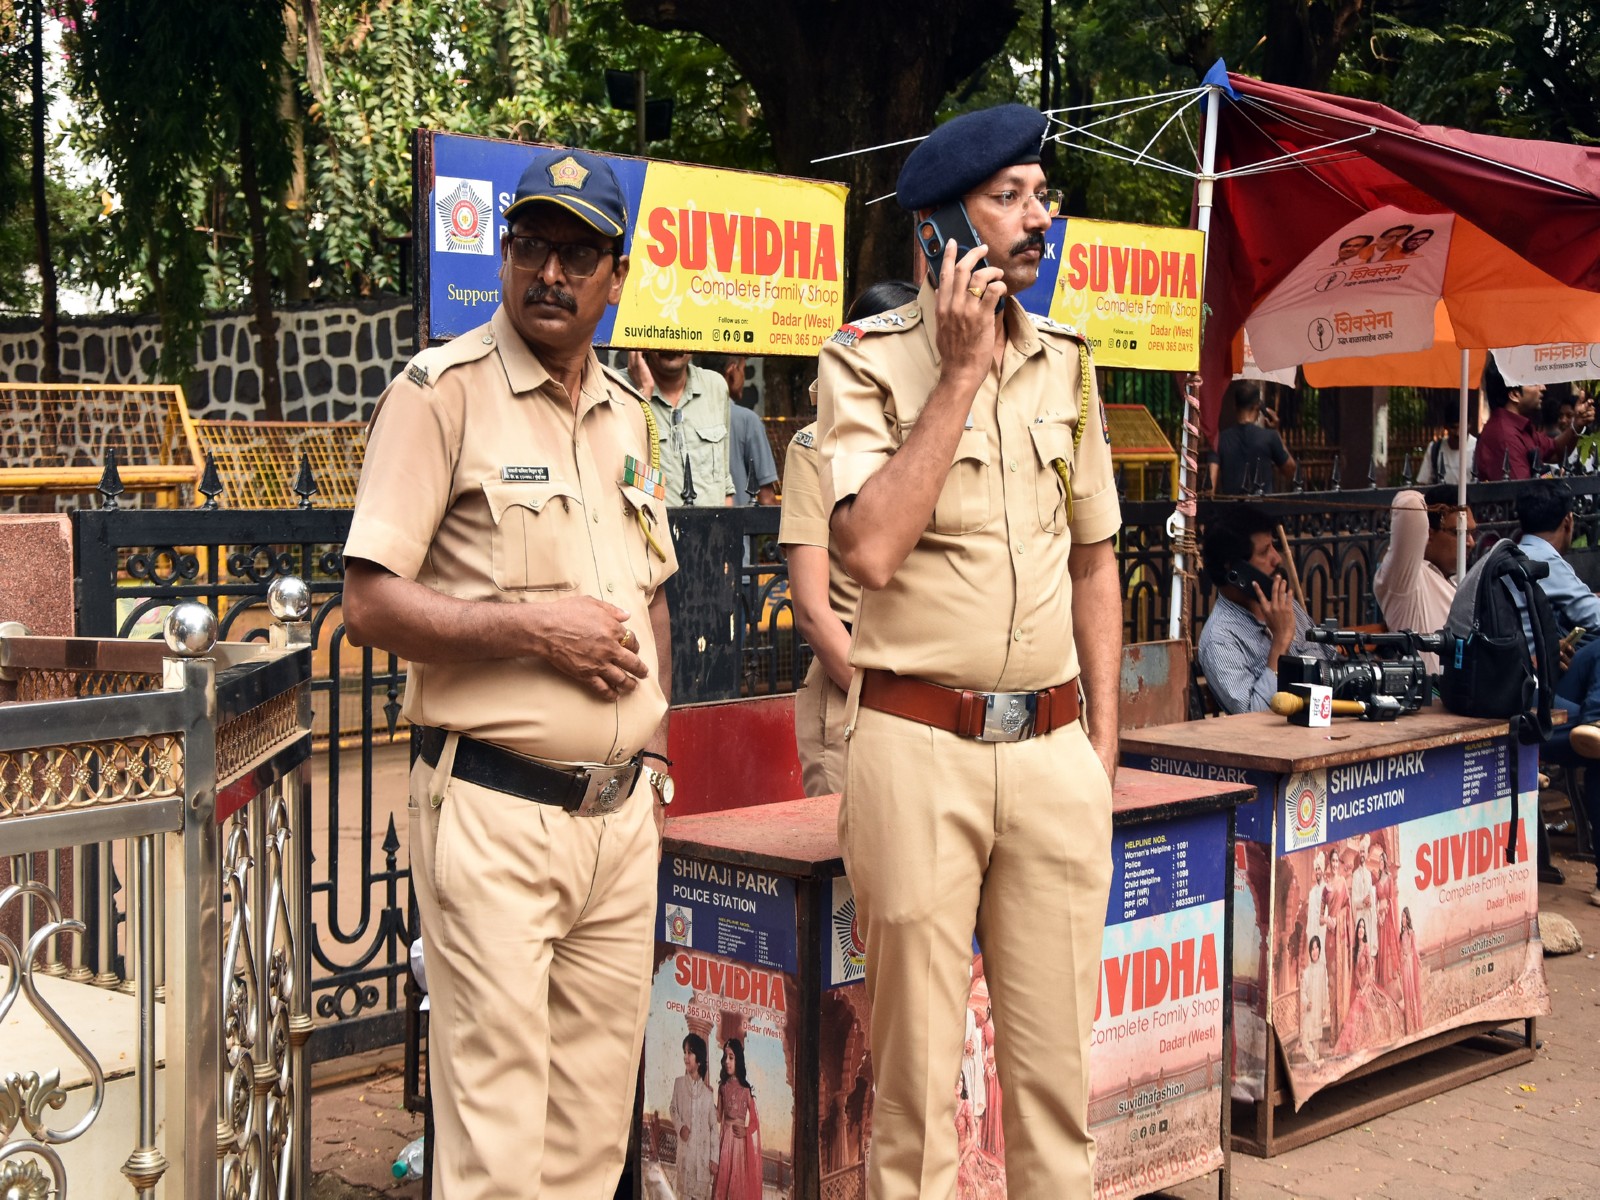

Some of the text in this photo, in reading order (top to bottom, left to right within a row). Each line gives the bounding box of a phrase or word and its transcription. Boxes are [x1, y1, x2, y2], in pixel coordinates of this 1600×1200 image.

[646, 206, 838, 282] SUVIDHA
[1068, 243, 1197, 299] SUVIDHA
[1349, 263, 1410, 280] शिवसेना
[448, 283, 499, 306] Support
[691, 275, 839, 307] Complete Family Shop
[1096, 296, 1198, 319] Complete Family Shop
[718, 316, 734, 324] Follow
[772, 311, 834, 332] Dadar (West)
[1150, 324, 1194, 338] Dadar (West)
[1334, 309, 1393, 335] शिवसेना
[624, 325, 703, 341] suvidhafashion
[769, 333, 793, 345] OPEN
[795, 333, 810, 346] 365
[812, 335, 831, 346] DA
[1148, 341, 1194, 353] OPEN 365 DAYS
[1151, 757, 1247, 785] SHIVAJI PARK
[1330, 750, 1425, 794] SHIVAJI PARK
[1330, 798, 1365, 822] POLICE
[1366, 788, 1405, 813] STATION
[1124, 835, 1167, 849] HELPLINE NOS.
[1124, 841, 1188, 860] Women's Helpline 1091
[1124, 851, 1187, 869] Police 100
[1414, 817, 1529, 891] SUVIDHA
[673, 857, 779, 897] SHIVAJI PARK
[1124, 860, 1187, 879] Ambulance 108
[1124, 869, 1189, 889] Child Helpline 1098
[1124, 879, 1188, 899] RPF (WR) 1311
[1439, 868, 1530, 904] Complete Family Shop
[673, 884, 756, 914] POLICE STATION
[1124, 888, 1188, 909] RPF (CR) 1275
[1486, 889, 1526, 911] Dadar (West)
[1124, 909, 1137, 919] GRP
[1460, 933, 1505, 956] suvidhafashion
[674, 954, 786, 1012] SUVIDHA
[1094, 932, 1219, 1022] VIDHA
[666, 1000, 721, 1023] OPEN 365 DAYS
[696, 992, 786, 1026] Complete Family Shop
[1153, 1004, 1189, 1029] Family
[1192, 997, 1220, 1017] Shop
[743, 1020, 784, 1040] Dadar (West)
[1159, 1024, 1216, 1054] Dadar (West)
[1118, 1082, 1185, 1113] suvidhafashion
[1139, 1159, 1166, 1186] 365
[1168, 1144, 1209, 1176] DAYS
